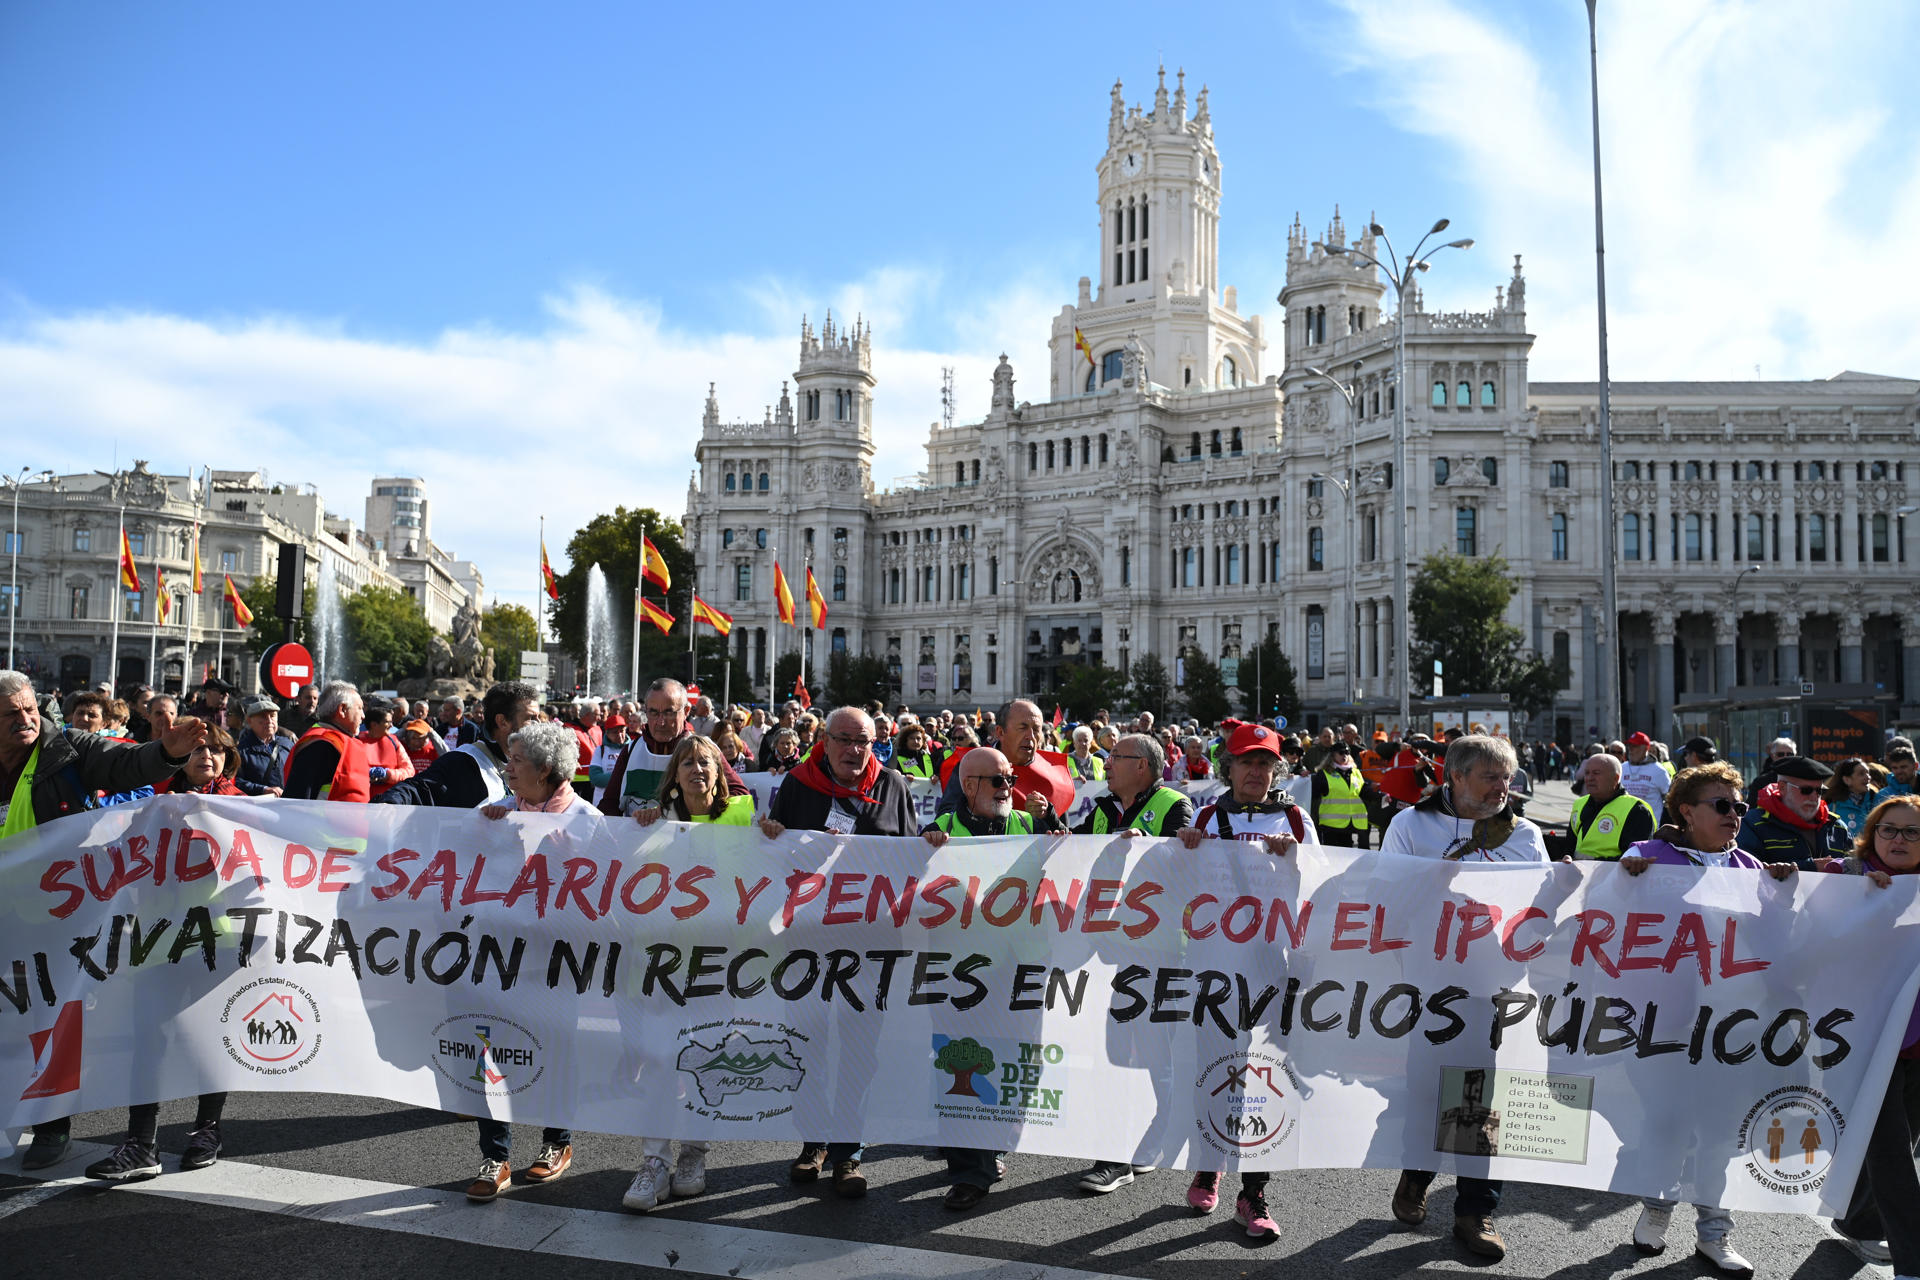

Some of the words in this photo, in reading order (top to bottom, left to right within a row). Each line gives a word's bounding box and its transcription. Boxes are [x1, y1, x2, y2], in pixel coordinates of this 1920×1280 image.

[1812, 726, 1831, 736] No
[1833, 727, 1864, 739] apto
[1813, 741, 1845, 750] para
[829, 812, 853, 825] UNIDAD
[40, 828, 265, 919] SUBIDA
[283, 844, 361, 893] DE
[371, 849, 716, 921] SALARIOS
[734, 876, 772, 924] Y
[782, 869, 1165, 939] PENSIONES
[1183, 893, 1313, 948] CON
[1331, 903, 1412, 953] EL
[1434, 900, 1549, 963] IPC
[1572, 907, 1772, 985] REAL
[0, 952, 57, 1014] NI
[547, 939, 621, 997] NI
[642, 943, 993, 1012] RECORTES
[1010, 964, 1089, 1016] EN
[1110, 964, 1471, 1046] SERVICIOS
[1490, 981, 1855, 1070] PÚBLICOS
[220, 981, 258, 1023] Coordinadora
[258, 977, 285, 985] Estatal
[285, 980, 299, 990] por
[298, 987, 306, 995] la
[304, 993, 321, 1023] Defensa
[777, 1023, 810, 1042] Defensa
[222, 1036, 232, 1048] del
[227, 1047, 255, 1071] Sistema
[255, 1066, 287, 1075] Público
[288, 1064, 298, 1072] de
[298, 1033, 322, 1067] Pensiones
[439, 1039, 476, 1060] EHPM
[492, 1047, 533, 1067] MPEH
[1018, 1042, 1063, 1064] MO
[1001, 1063, 1040, 1085] DE
[1196, 1053, 1234, 1088] Coordinadora
[1262, 1054, 1275, 1062] por
[1281, 1063, 1299, 1090] Defensa
[716, 1076, 764, 1088] MADPP
[1510, 1077, 1577, 1090] Plataforma
[1000, 1085, 1063, 1110] PEN
[1508, 1088, 1524, 1097] de
[1528, 1090, 1576, 1101] Badajoz
[934, 1103, 974, 1112] Movemento
[975, 1105, 999, 1114] Galego
[1001, 1107, 1016, 1116] pola
[1018, 1109, 1045, 1118] Defensa
[1508, 1101, 1535, 1109] para
[1539, 1102, 1549, 1110] la
[1769, 1101, 1819, 1116] PENSIONISTAS
[712, 1110, 753, 1121] Pensiones
[756, 1105, 793, 1122] Públicas
[939, 1111, 970, 1120] Pensións
[993, 1115, 1022, 1123] Servizos
[1023, 1117, 1053, 1126] Públicos
[1507, 1110, 1556, 1121] Defensa
[1737, 1099, 1767, 1149] PLATAFORMA
[1765, 1085, 1823, 1101] PENSIONISTAS
[1822, 1096, 1833, 1107] DE
[1830, 1106, 1847, 1136] MÓST
[1506, 1122, 1521, 1130] de
[1525, 1122, 1541, 1131] las
[1202, 1132, 1228, 1155] Sistema
[1230, 1149, 1258, 1158] Público
[1271, 1118, 1296, 1150] Pensiones
[1505, 1132, 1567, 1145] Pensiones
[1504, 1143, 1554, 1155] Públicas
[1745, 1162, 1799, 1193] PENSIONES
[1773, 1169, 1811, 1181] MÓSTOLES
